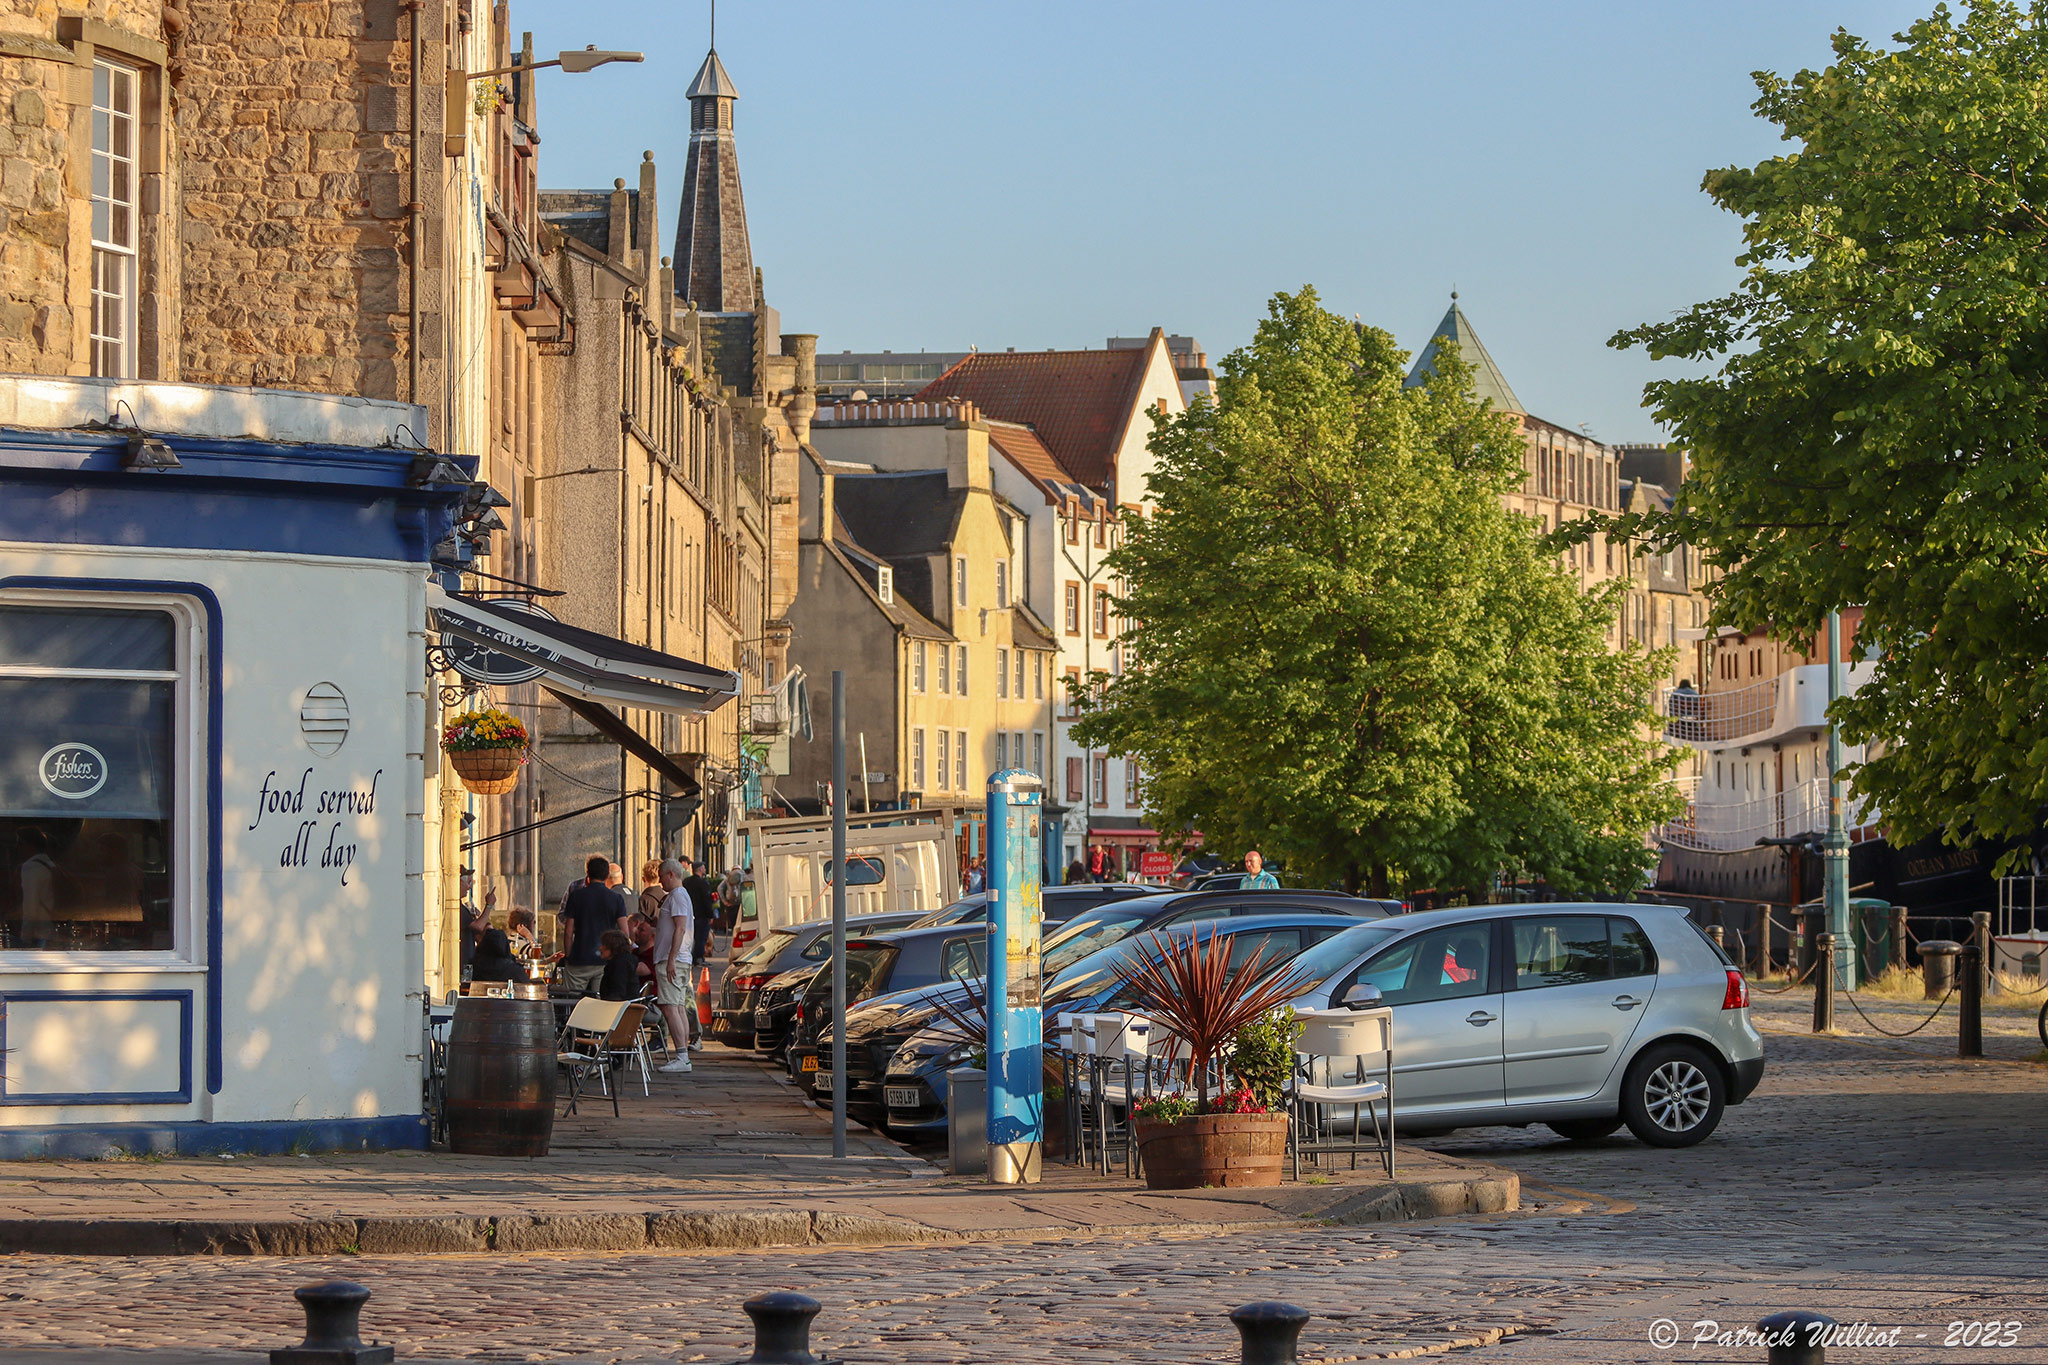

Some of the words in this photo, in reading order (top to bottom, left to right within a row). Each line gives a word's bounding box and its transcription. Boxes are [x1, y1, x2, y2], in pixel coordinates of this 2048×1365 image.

[51, 752, 93, 782] fishers
[249, 767, 313, 831] food
[317, 769, 382, 815] served
[280, 820, 317, 868] all
[321, 822, 356, 887] day
[1148, 855, 1168, 863] ROAD
[1907, 856, 1945, 877] OCEAN
[1947, 849, 1980, 869] MIST
[1144, 865, 1172, 873] CLOSED
